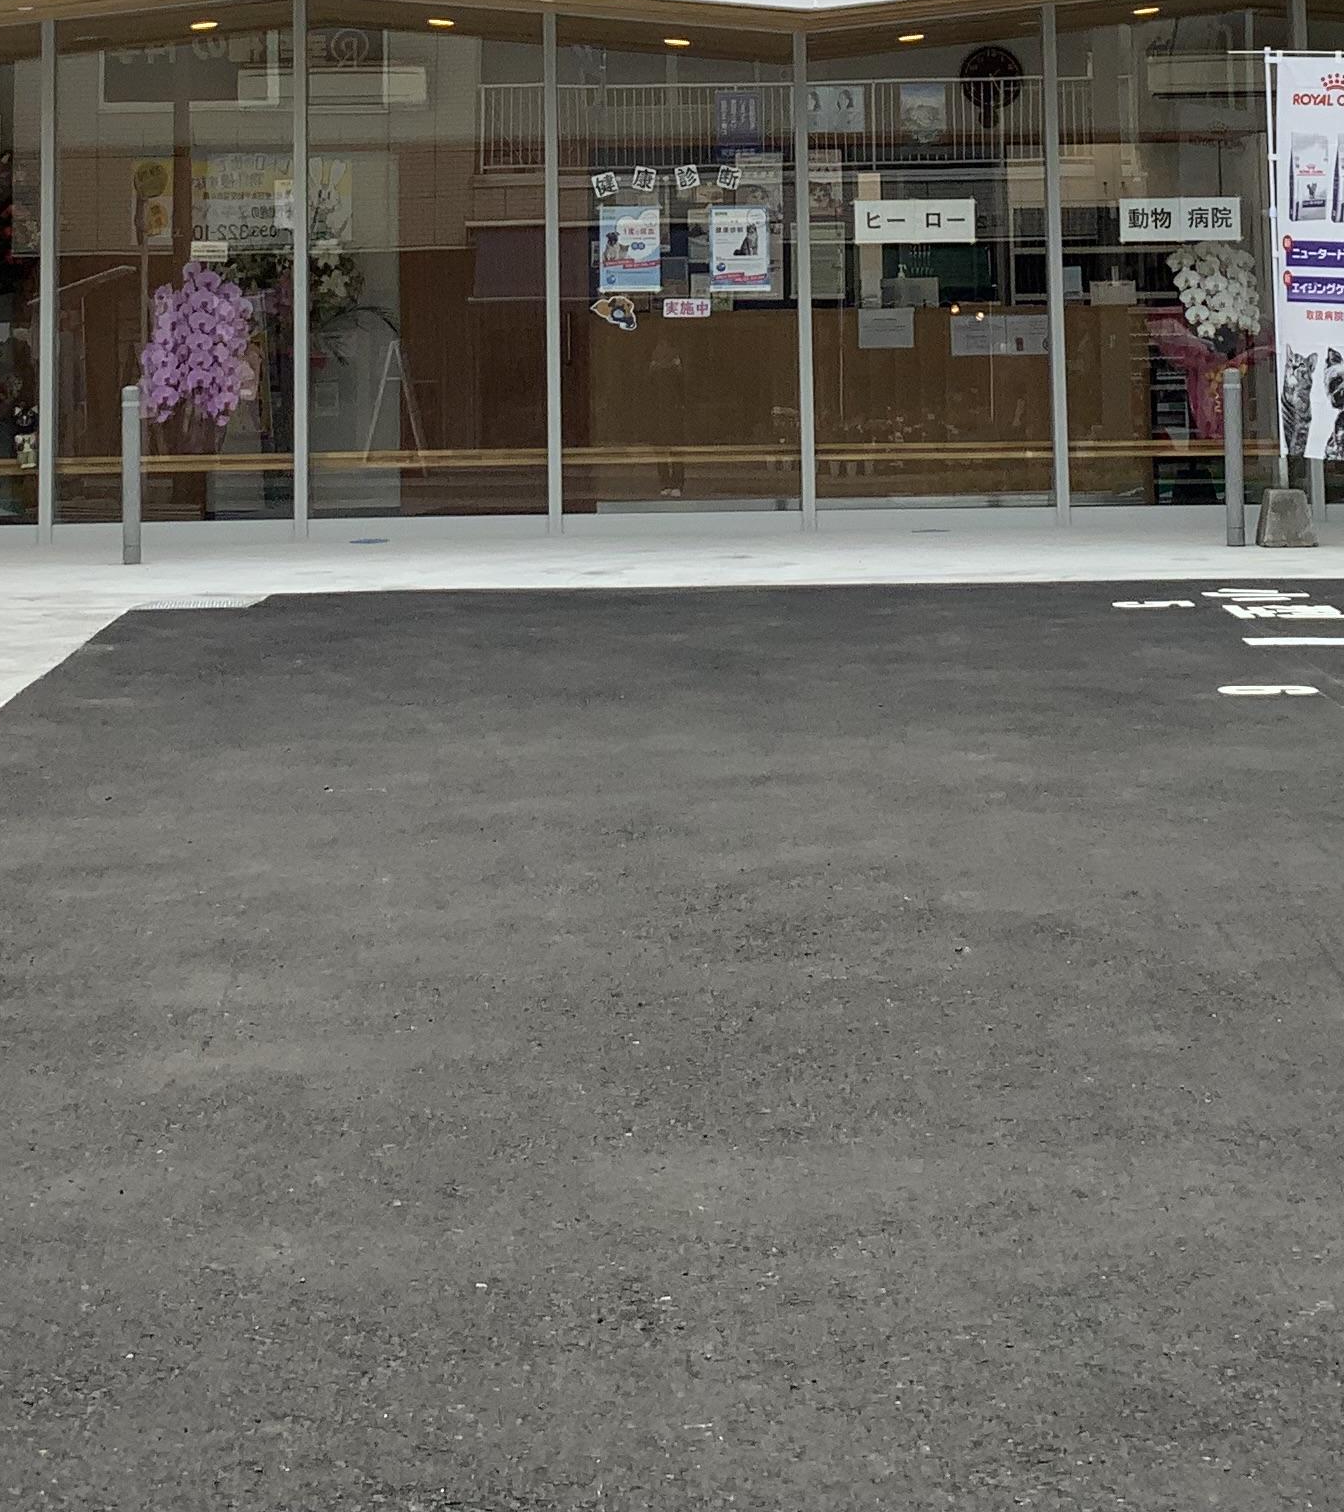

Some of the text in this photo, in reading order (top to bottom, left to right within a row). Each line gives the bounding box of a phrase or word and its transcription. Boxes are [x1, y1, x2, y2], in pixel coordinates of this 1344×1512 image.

[1293, 93, 1334, 106] ROYAL
[594, 164, 741, 197] 健康診断
[866, 206, 1233, 230] ヒーロー 動物病院
[664, 299, 710, 317] 実施中
[1111, 599, 1196, 609] 5
[1216, 684, 1321, 697] 6
